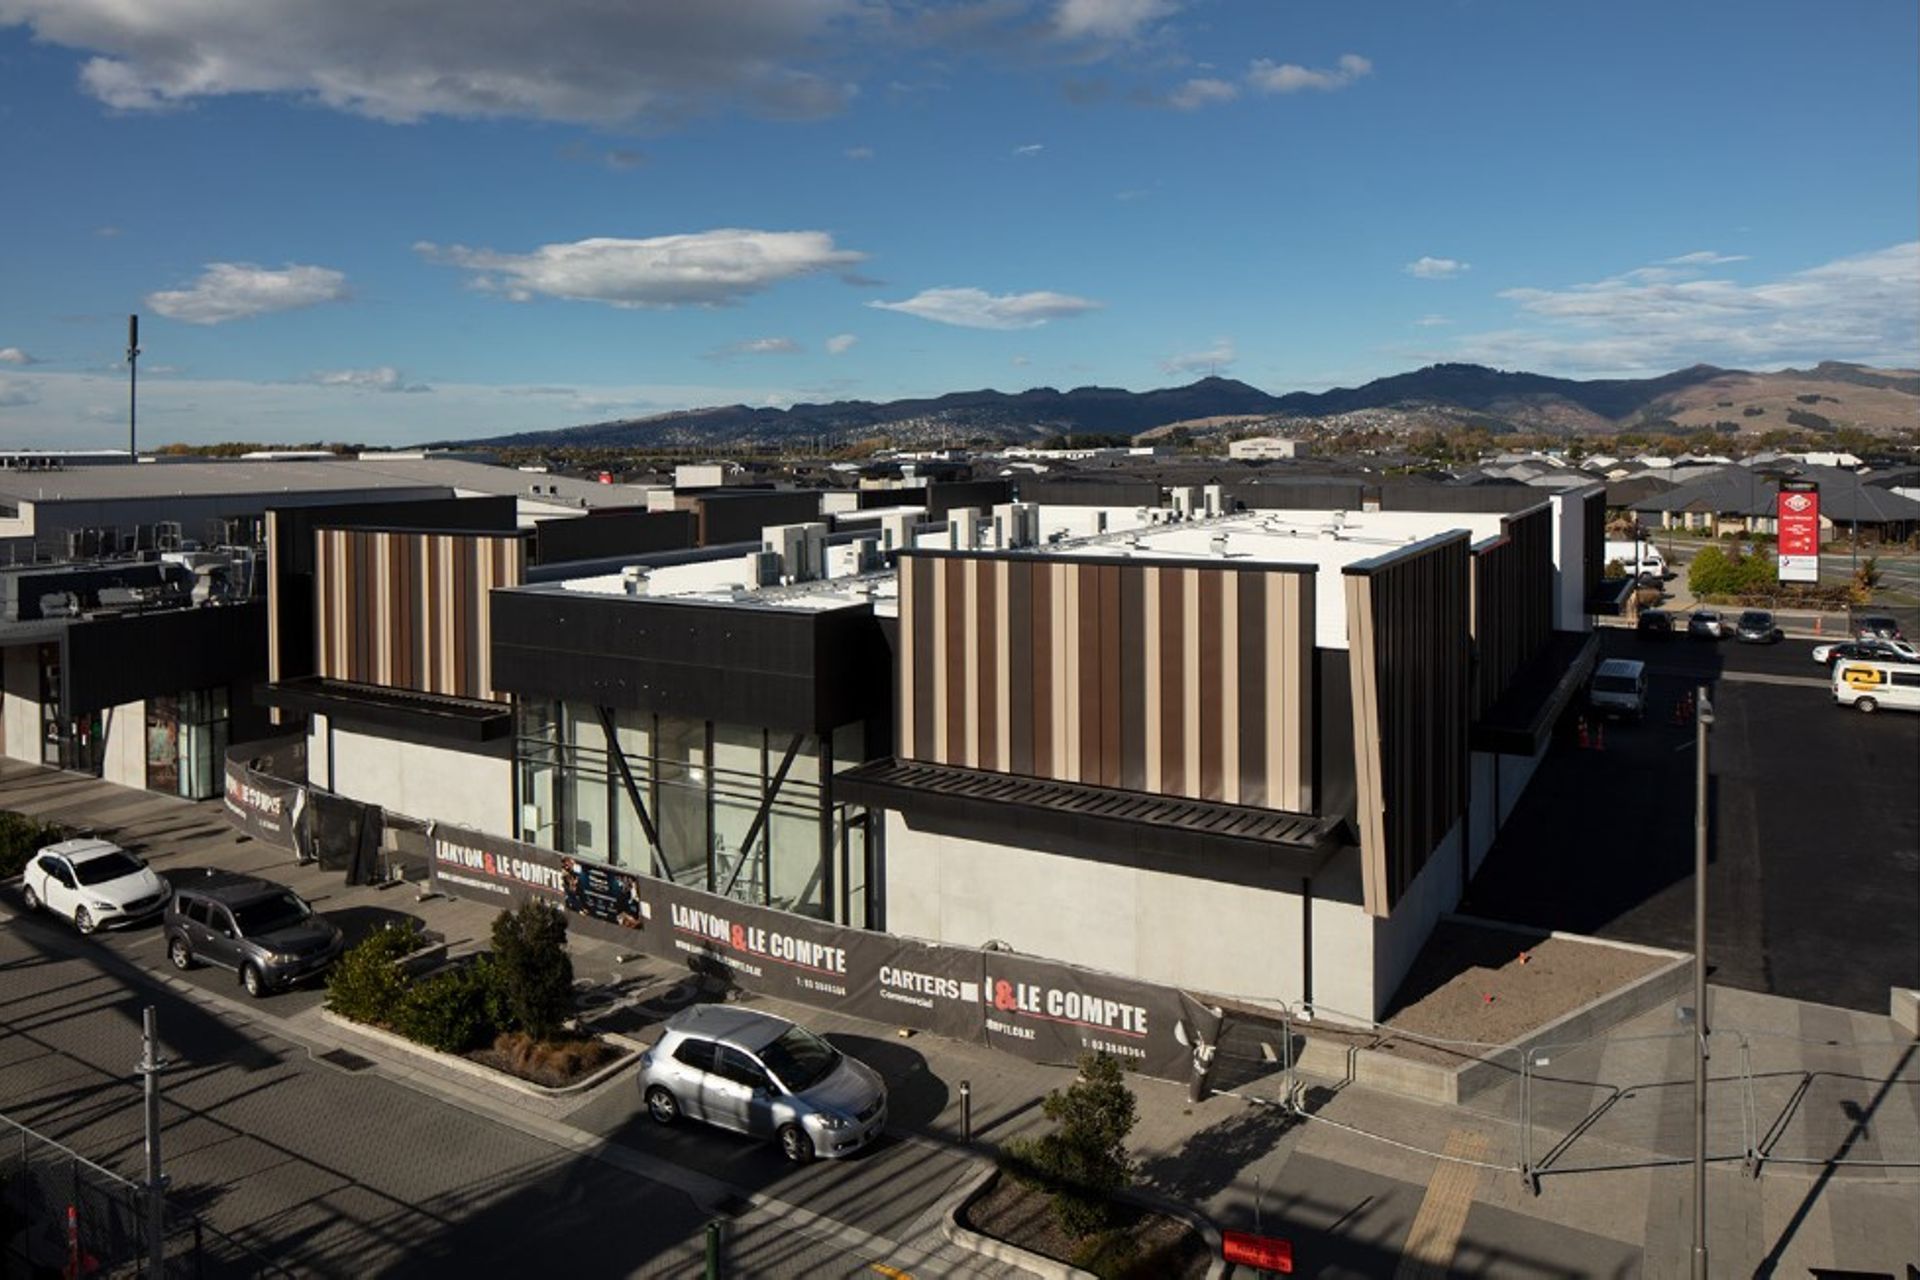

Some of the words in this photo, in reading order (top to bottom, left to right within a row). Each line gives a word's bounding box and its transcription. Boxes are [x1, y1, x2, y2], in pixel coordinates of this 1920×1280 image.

[436, 839, 484, 869] LANYON
[496, 854, 511, 876] LE
[512, 858, 564, 893] COMPTE
[671, 903, 731, 943] LANYON
[731, 924, 748, 953] &
[748, 926, 766, 953] LE
[770, 932, 847, 974] COMPTE
[879, 965, 960, 999] CARTERS
[880, 988, 934, 1009] Commercial
[995, 979, 1017, 1012] &
[1016, 982, 1041, 1013] LE
[1046, 988, 1149, 1035] COMPTE
